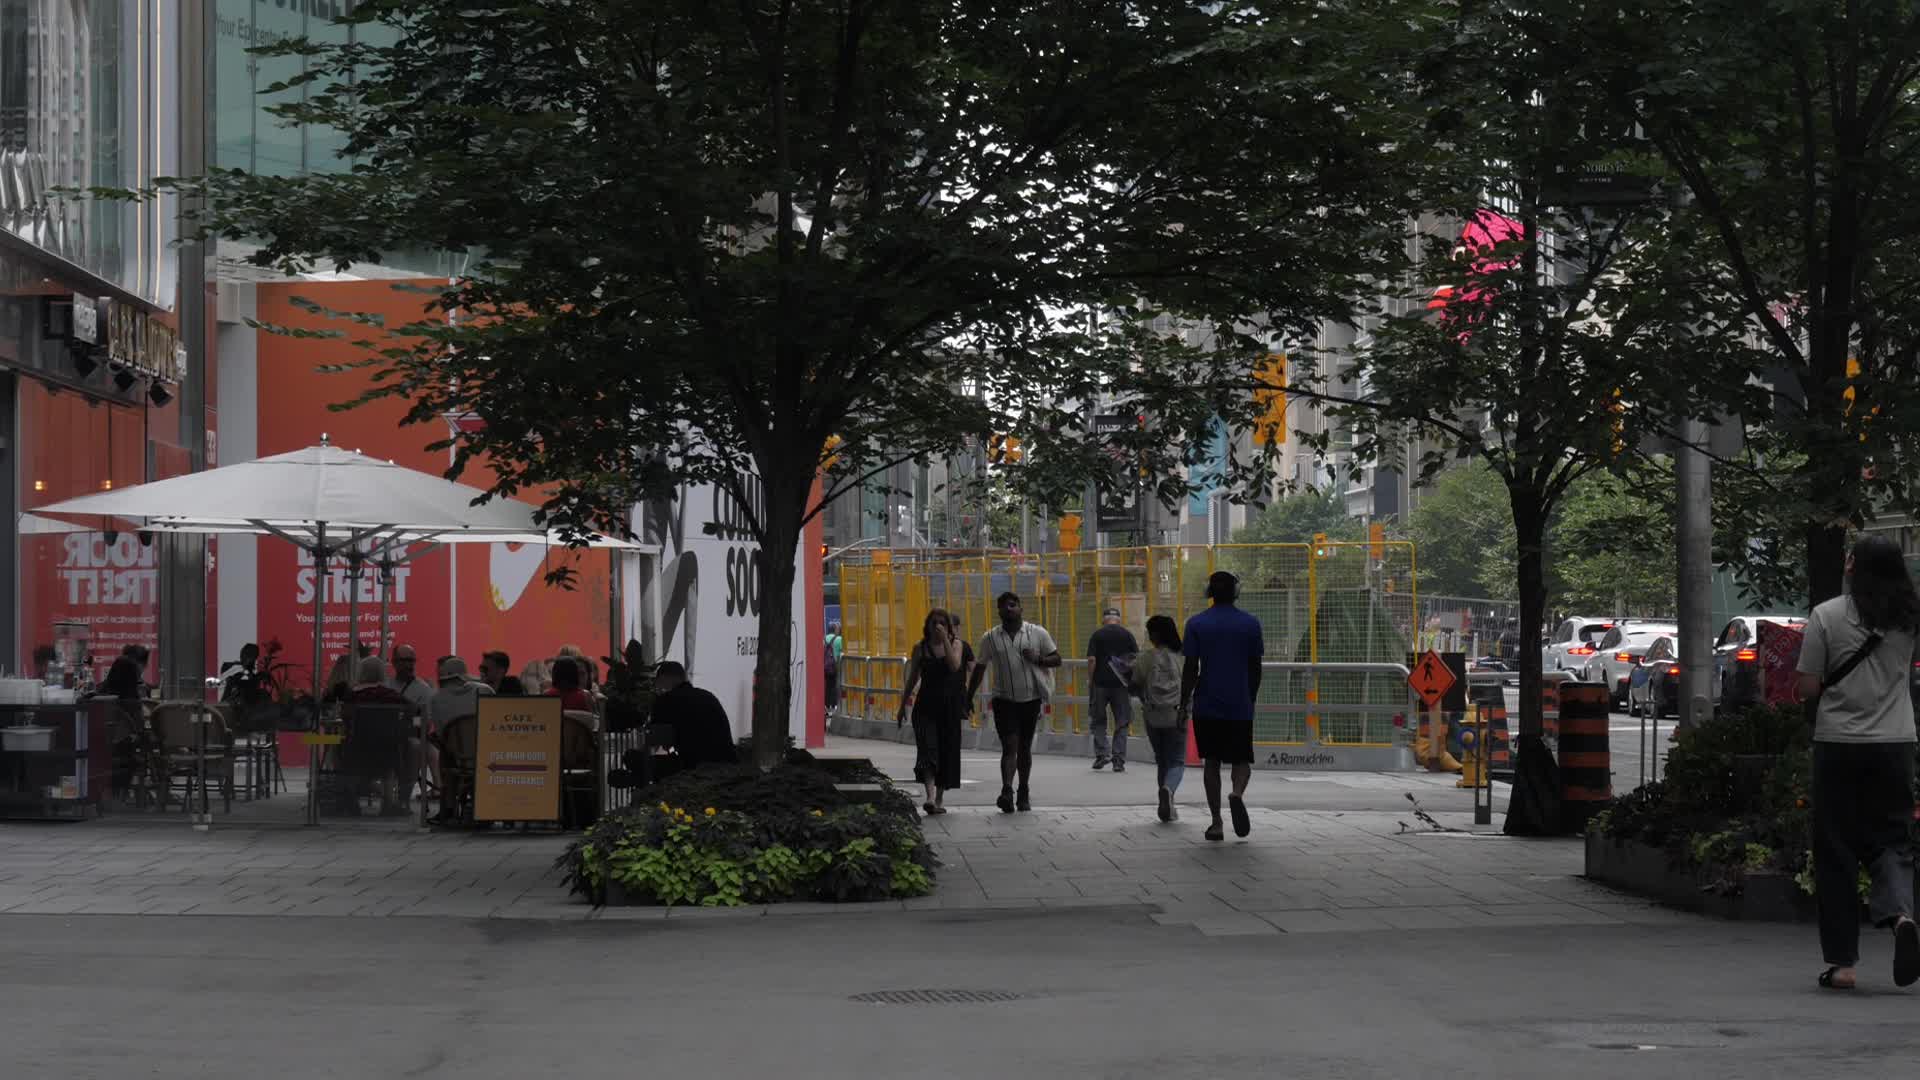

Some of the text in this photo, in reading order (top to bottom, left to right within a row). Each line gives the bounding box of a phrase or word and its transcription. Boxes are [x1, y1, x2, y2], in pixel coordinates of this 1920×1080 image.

[726, 546, 763, 618] SOO
[385, 613, 409, 625] port
[736, 636, 749, 656] Fall
[1280, 752, 1335, 766] Ramudden
